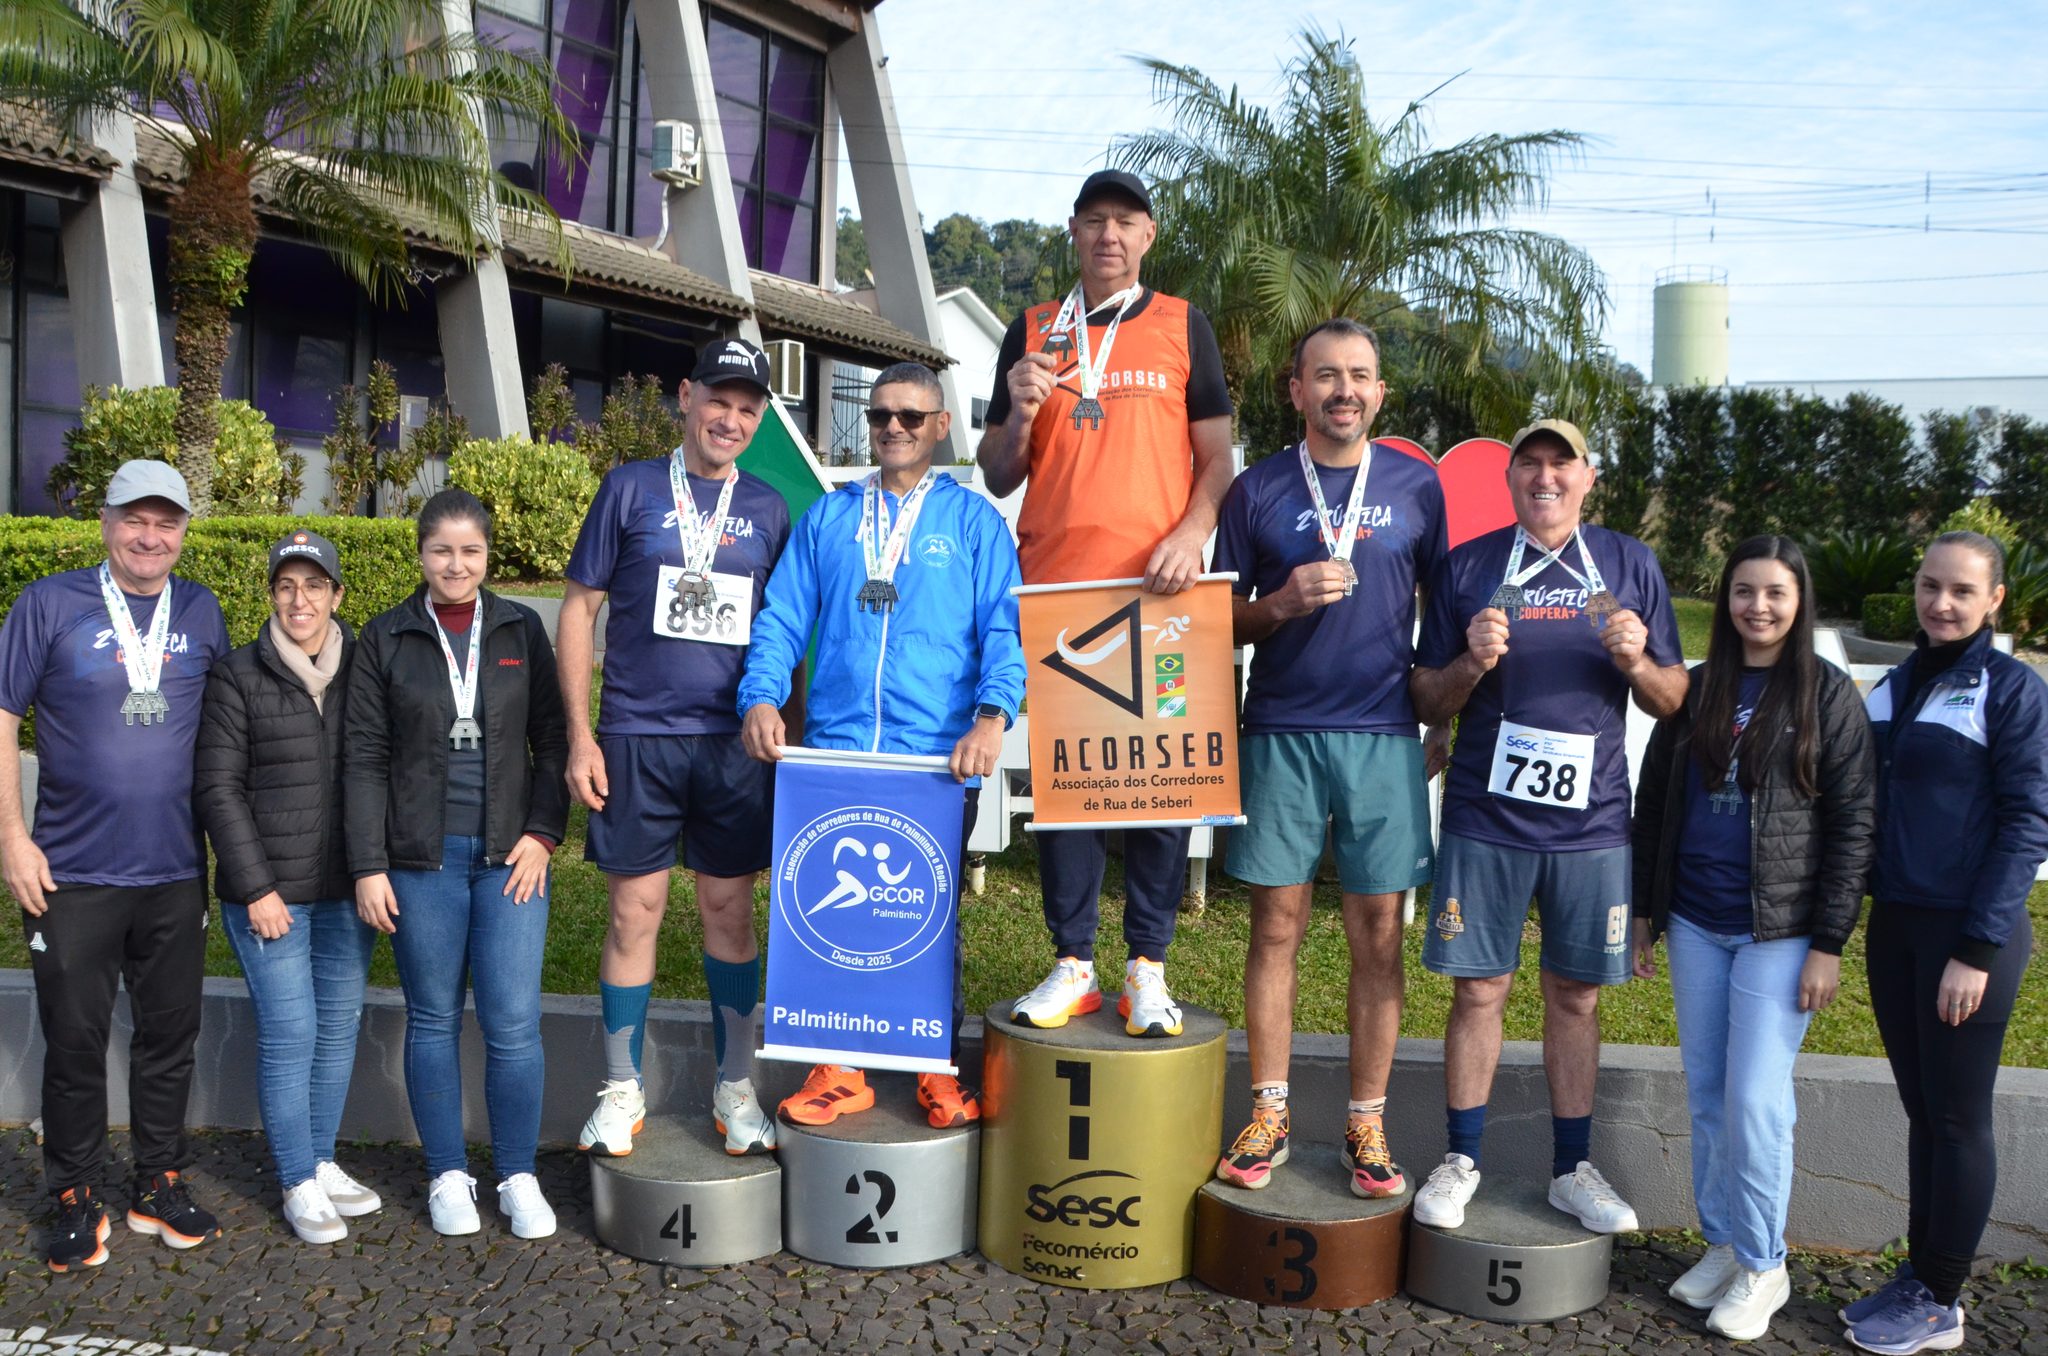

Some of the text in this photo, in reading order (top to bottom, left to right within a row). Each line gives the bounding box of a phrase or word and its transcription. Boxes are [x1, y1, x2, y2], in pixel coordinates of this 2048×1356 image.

[718, 355, 749, 367] PUMA
[1100, 370, 1167, 389] CORSEB
[279, 544, 322, 557] CRESOL
[1523, 585, 1589, 608] RÚSTIC
[666, 596, 737, 639] 896
[1053, 731, 1223, 773] ACORSEB
[1052, 772, 1225, 792] Associação dos Corredores
[1505, 753, 1577, 802] 738
[1083, 795, 1193, 811] de Rua de Seberi
[783, 811, 948, 893] Associação de Corredores de Rua de Palmitinho e Região
[868, 885, 925, 905] GCOR
[872, 908, 922, 920] Palmitinho
[831, 950, 893, 967] Desde 2025
[772, 1005, 891, 1035] Palmitinho
[911, 1018, 943, 1039] RS
[1055, 1059, 1092, 1161] 1
[845, 1169, 899, 1244] 2
[659, 1203, 697, 1249] 4
[1263, 1226, 1318, 1304] 3
[1486, 1259, 1523, 1307] 5
